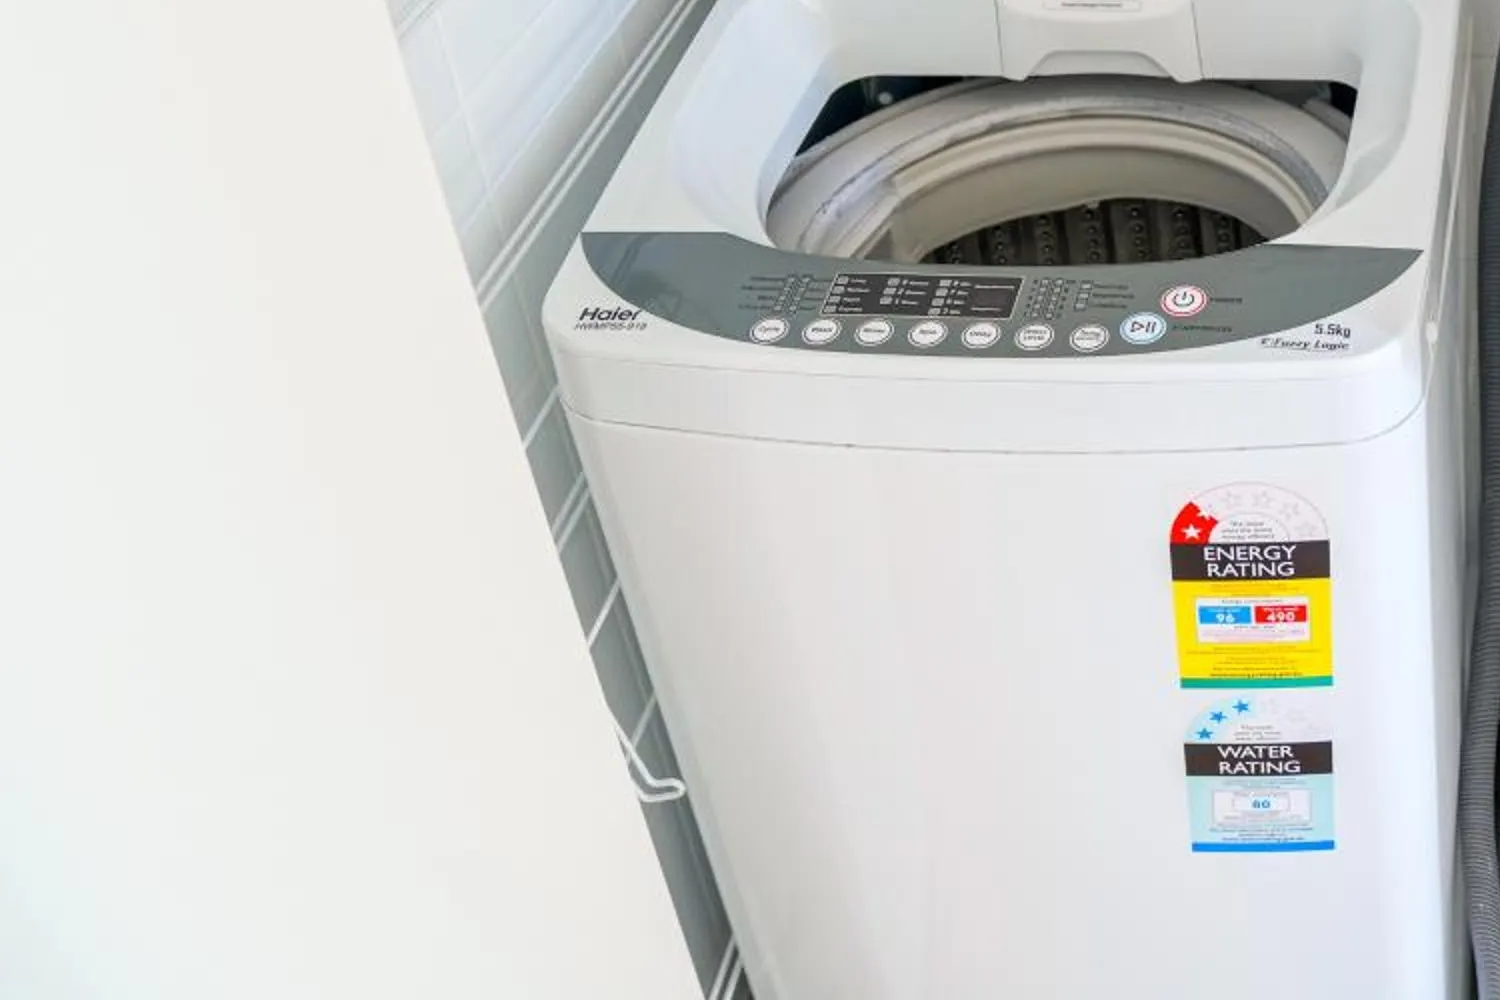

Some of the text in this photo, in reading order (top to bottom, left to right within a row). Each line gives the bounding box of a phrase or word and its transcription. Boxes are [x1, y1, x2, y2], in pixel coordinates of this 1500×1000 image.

[579, 306, 643, 321] Haier
[1314, 323, 1351, 339] 5.5kg
[1314, 340, 1350, 351] Logic
[1203, 545, 1296, 561] ENERGY
[1207, 562, 1295, 578] RATING
[1266, 611, 1296, 622] 490
[1217, 745, 1294, 759] WATER
[1219, 761, 1301, 775] RATING
